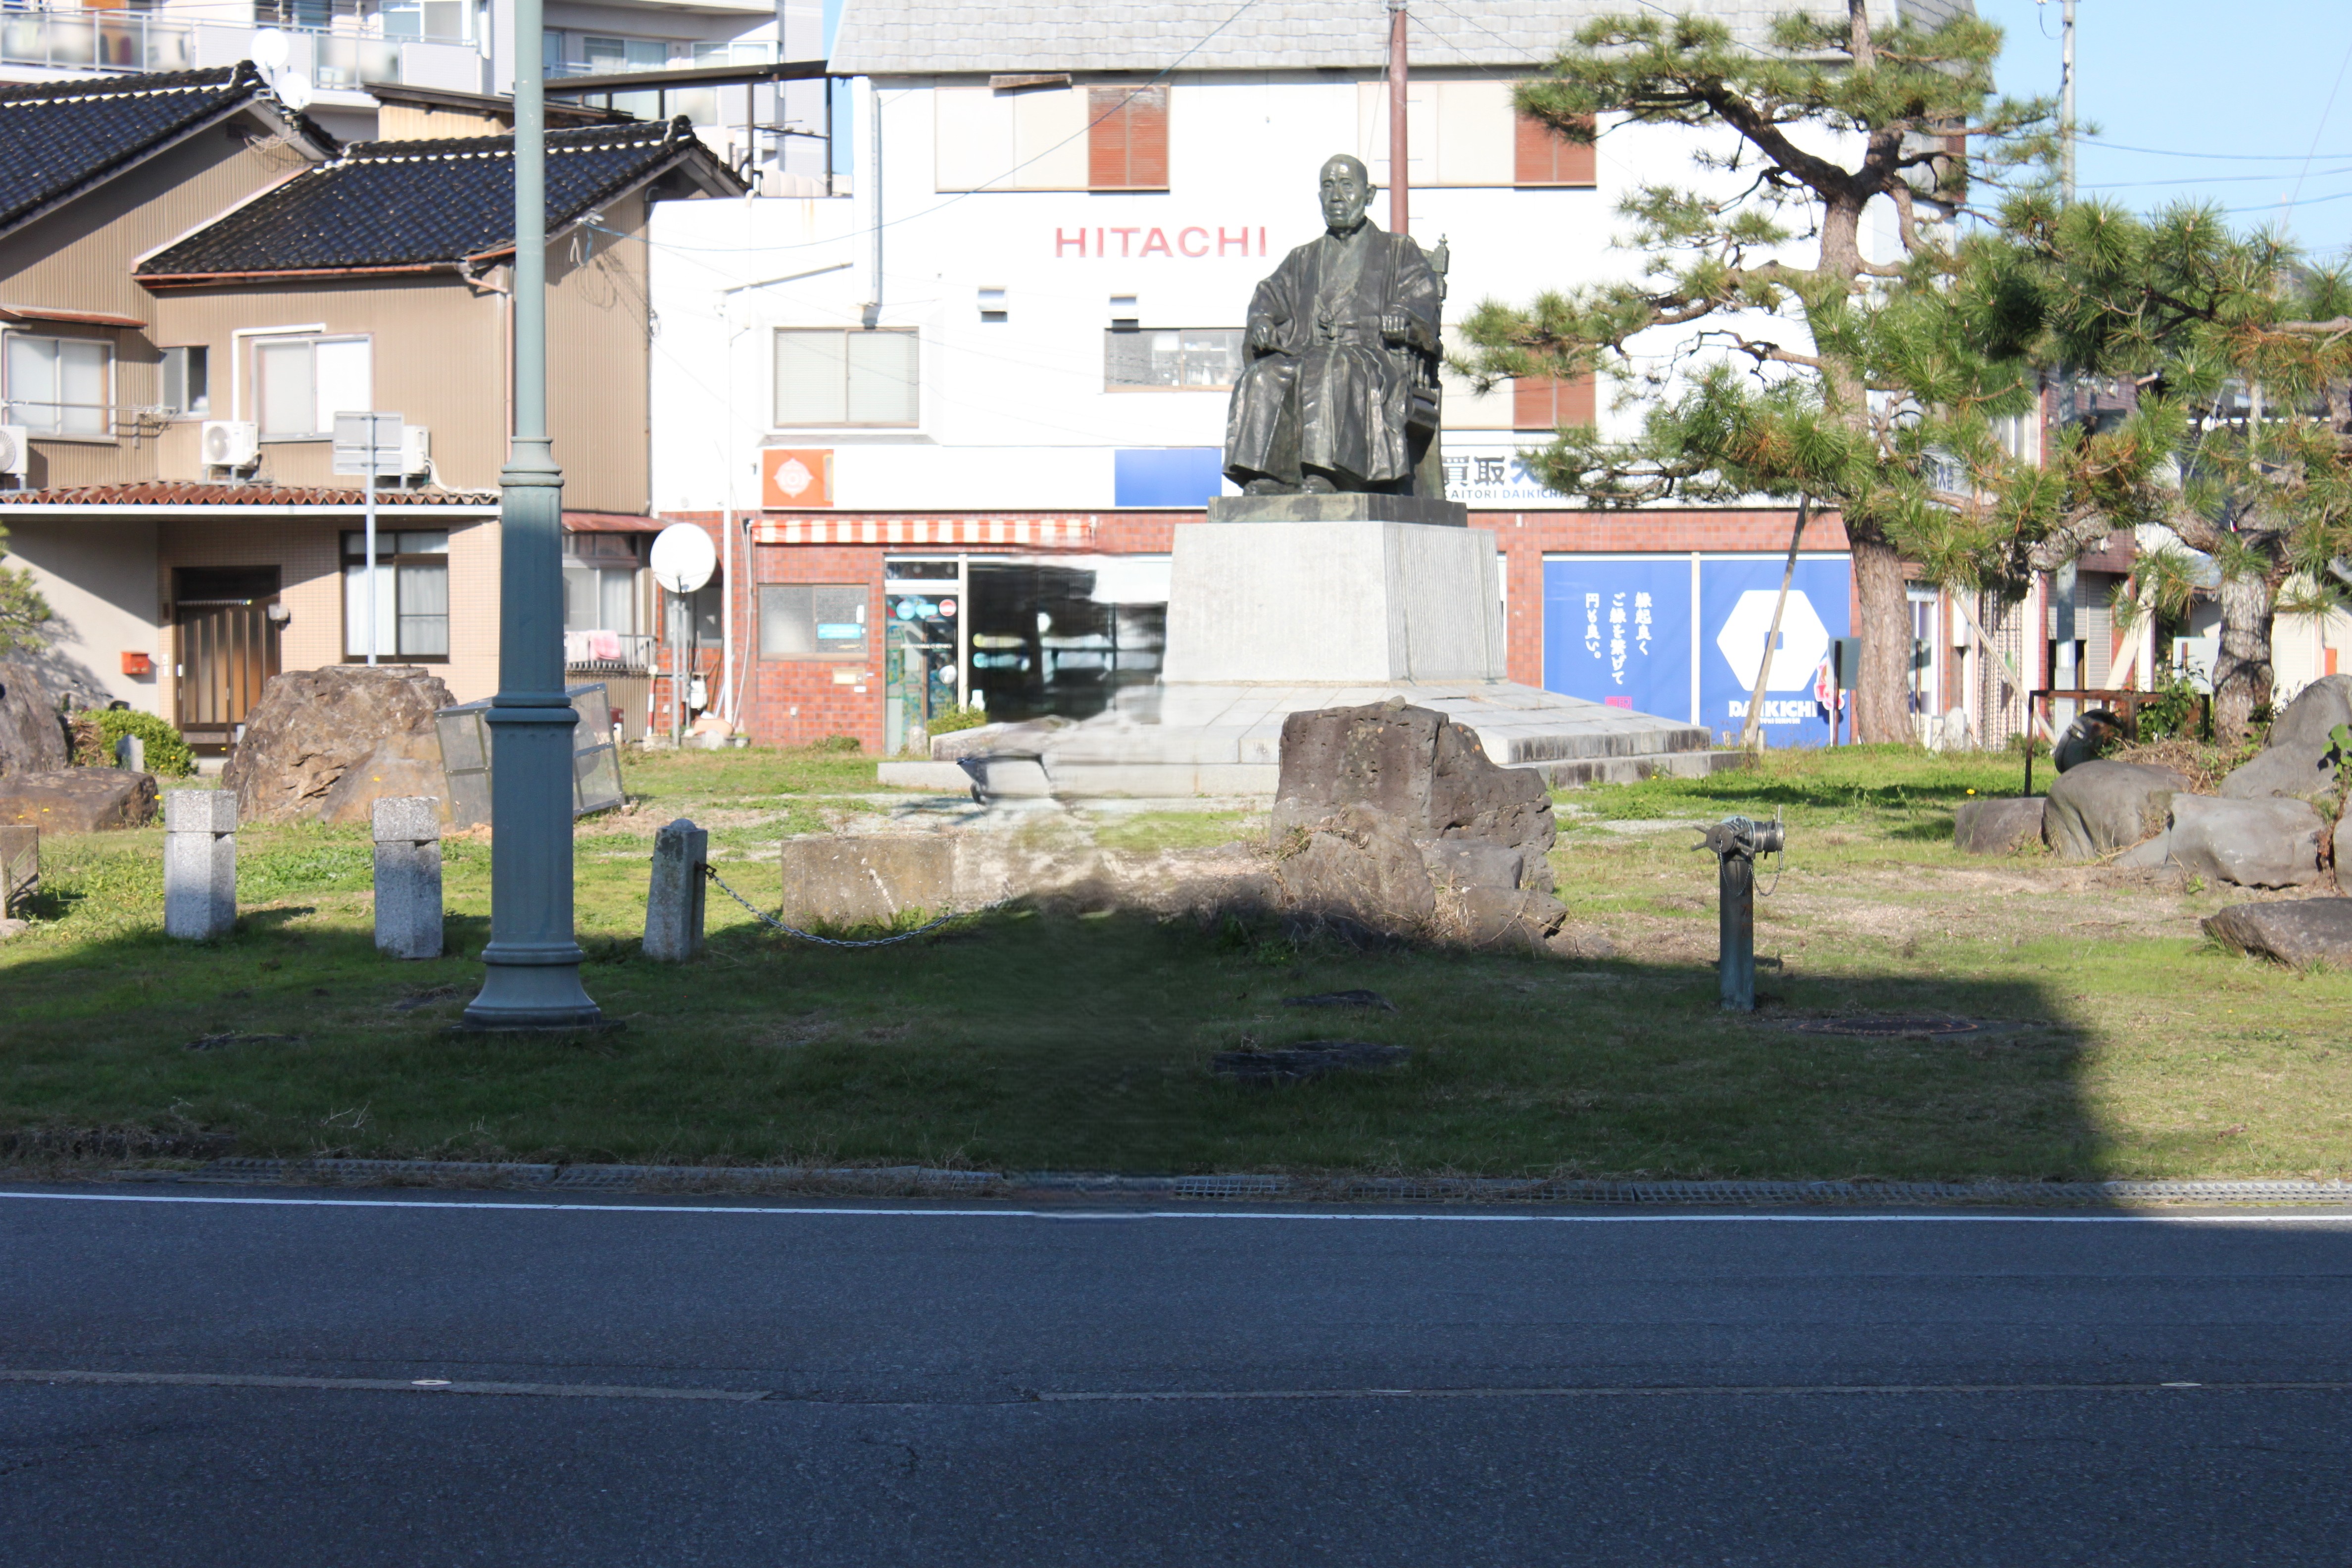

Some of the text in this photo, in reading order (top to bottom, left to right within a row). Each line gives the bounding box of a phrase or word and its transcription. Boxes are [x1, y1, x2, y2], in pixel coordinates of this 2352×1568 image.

[1055, 226, 1267, 258] HITACHI
[1634, 591, 1652, 655] 縁起良く
